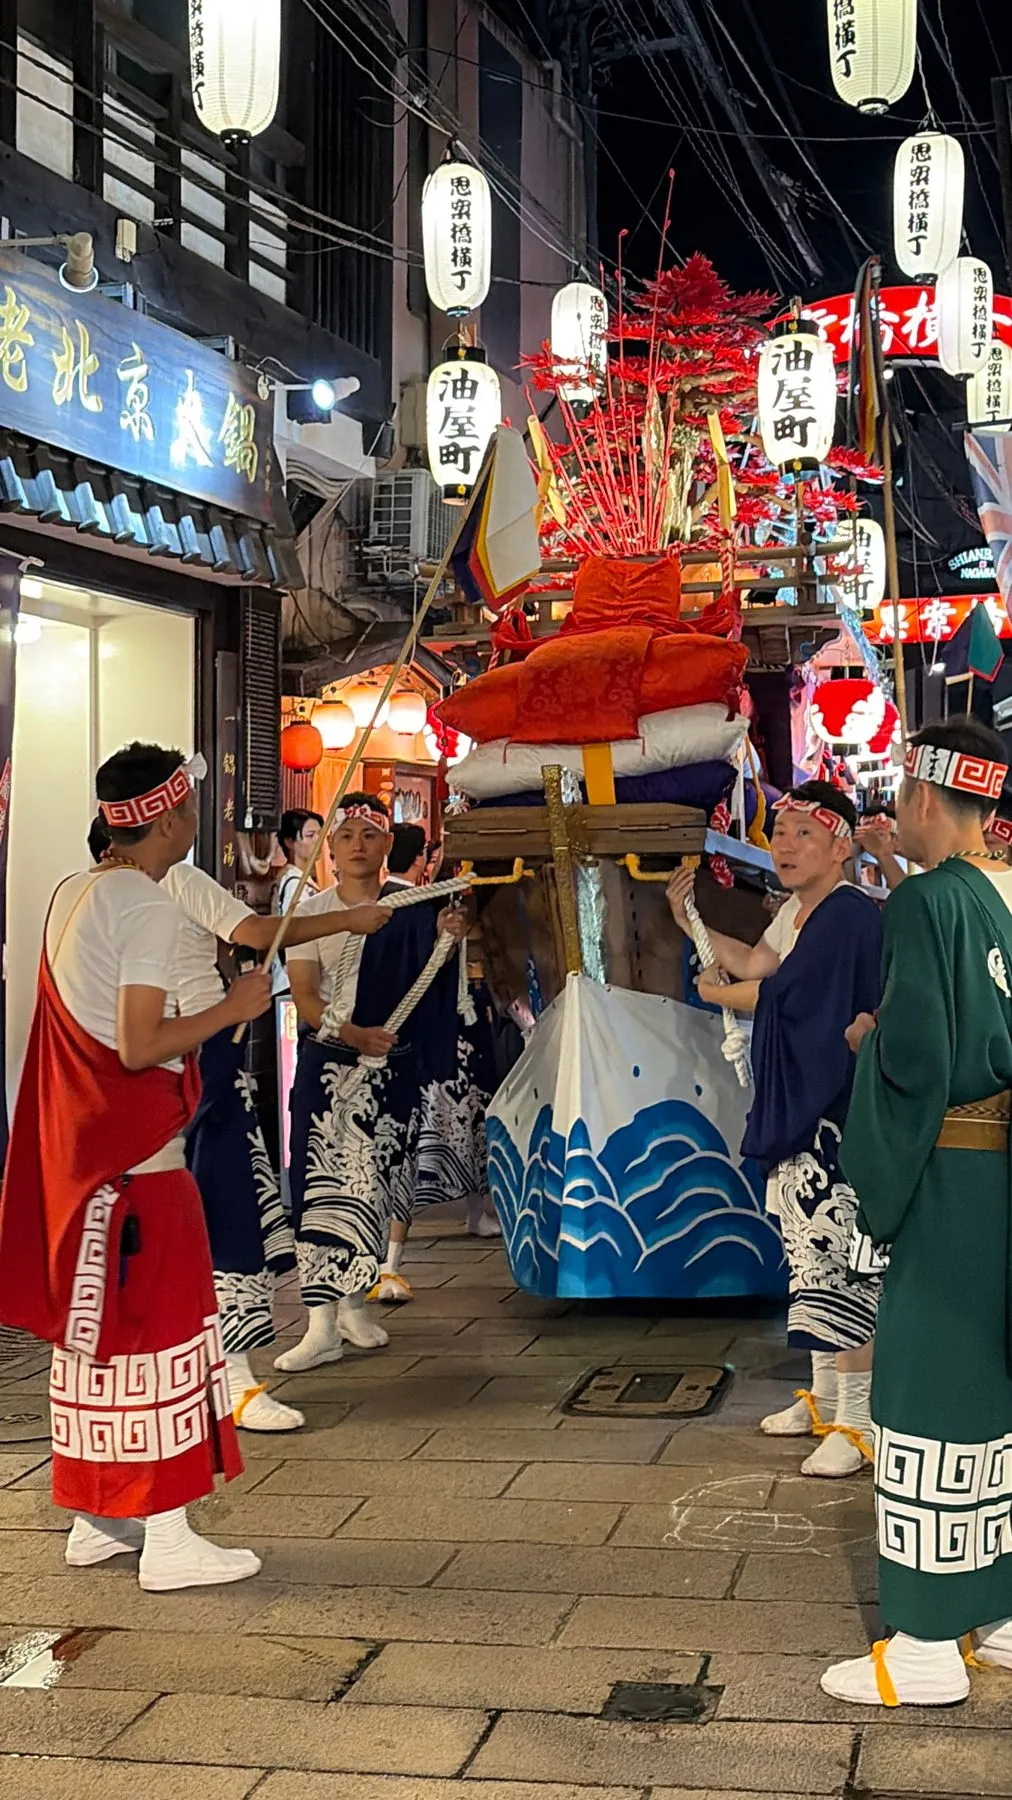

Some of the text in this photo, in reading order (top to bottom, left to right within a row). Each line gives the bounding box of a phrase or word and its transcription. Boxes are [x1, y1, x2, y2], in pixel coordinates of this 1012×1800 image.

[438, 367, 481, 476] 油屋町
[771, 340, 817, 448] 油屋町
